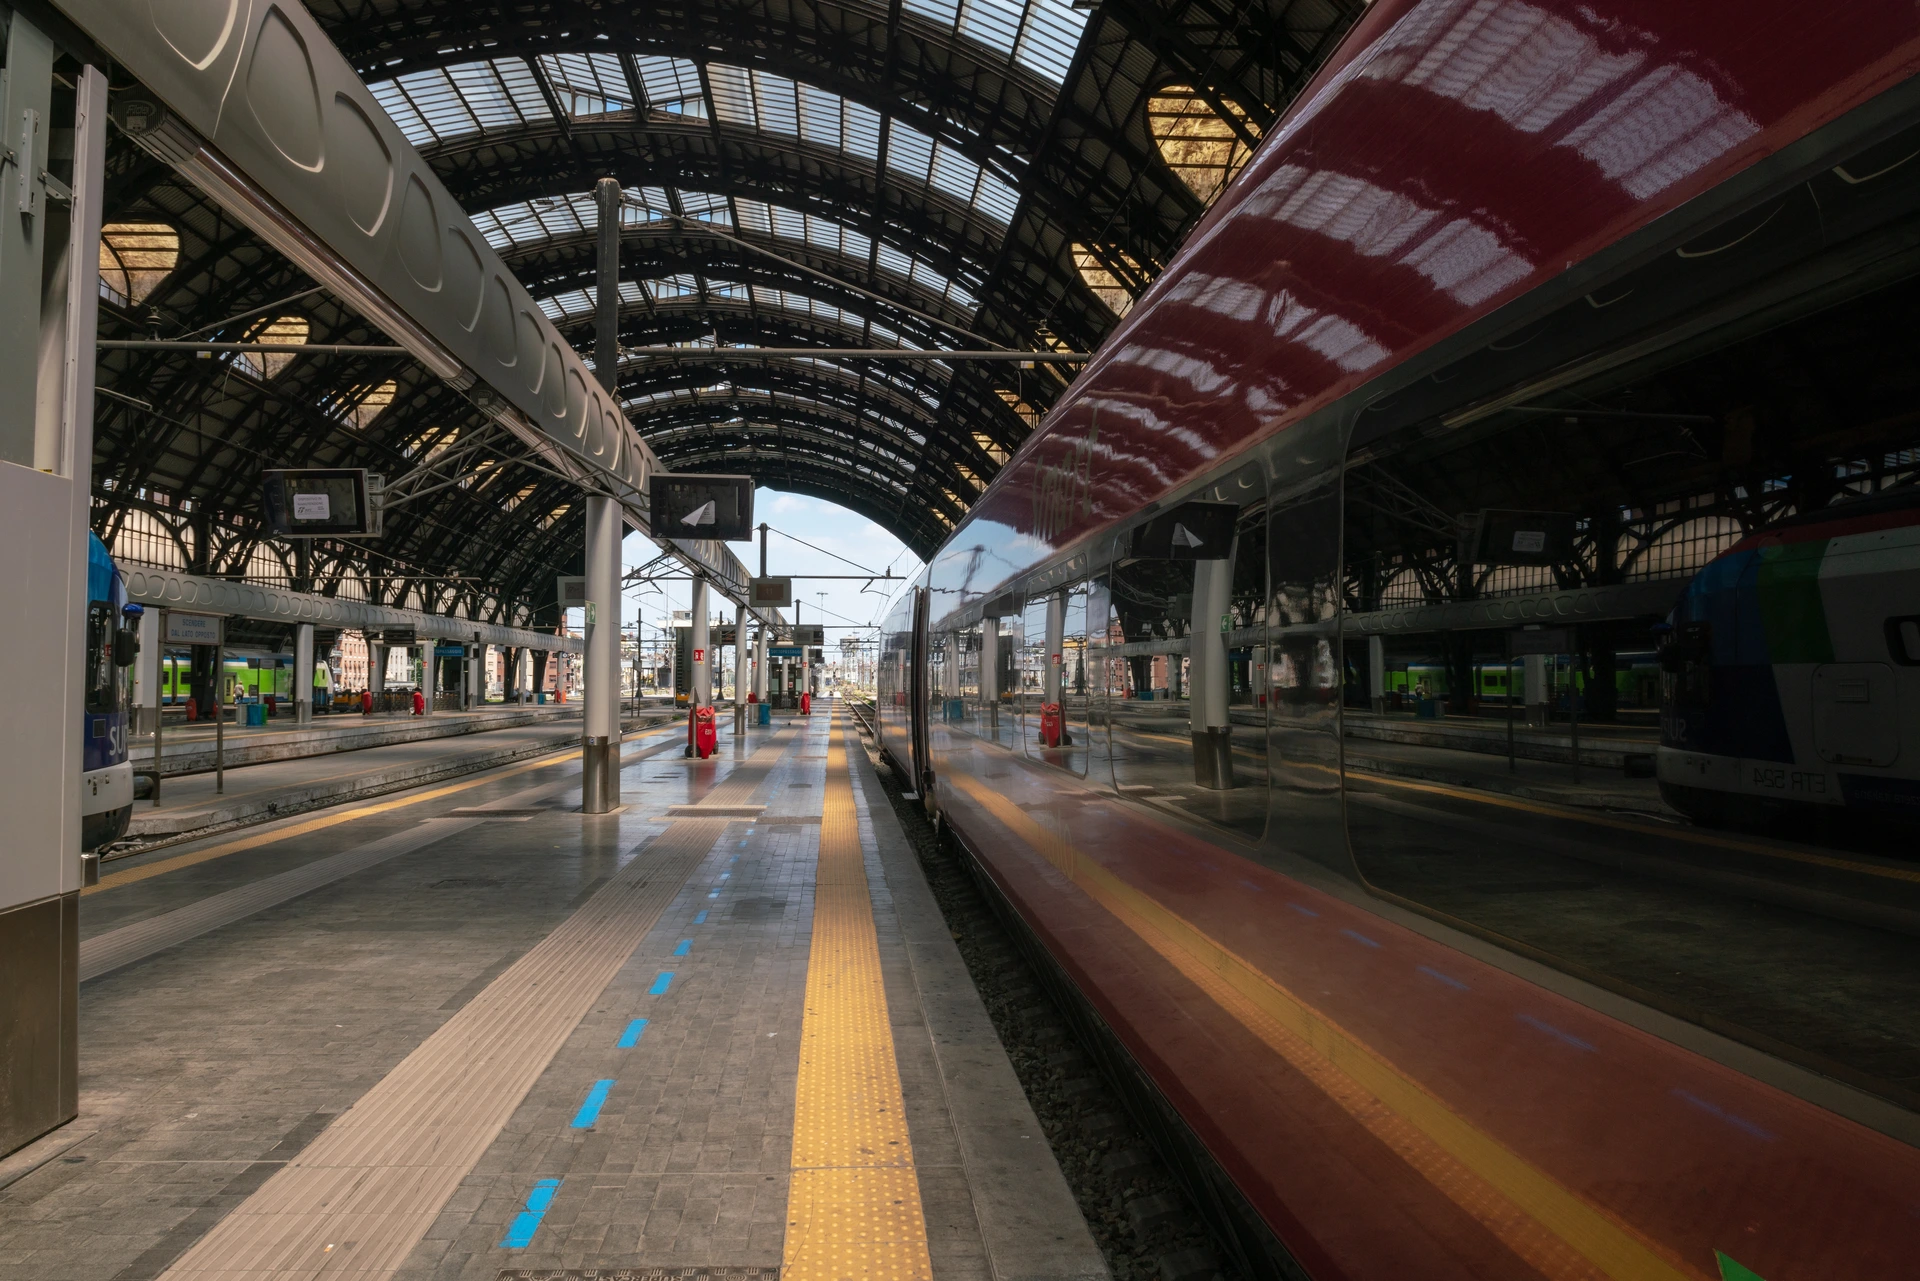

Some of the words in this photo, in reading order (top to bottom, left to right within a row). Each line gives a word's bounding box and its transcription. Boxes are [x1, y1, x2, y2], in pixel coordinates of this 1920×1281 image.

[182, 619, 206, 628] SCENDERE
[171, 629, 180, 637] DAL
[182, 630, 193, 638] LATO
[195, 631, 216, 639] OPPOSTO
